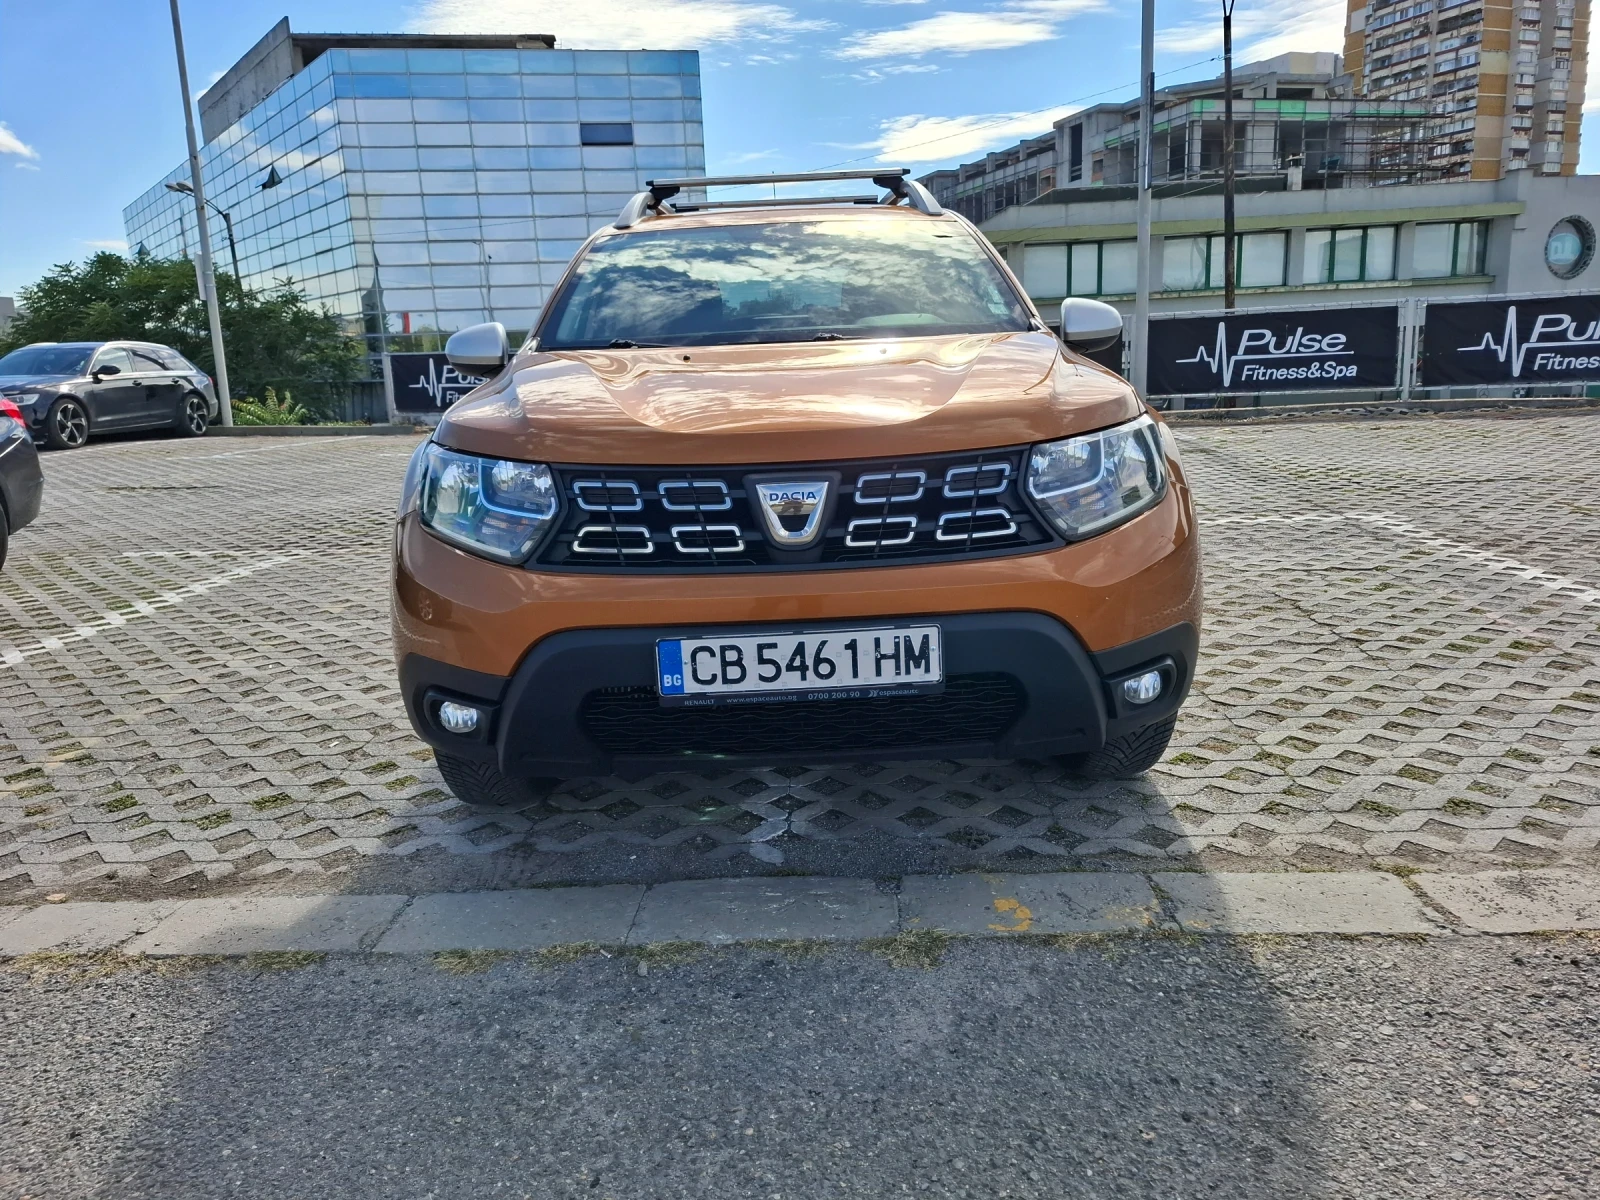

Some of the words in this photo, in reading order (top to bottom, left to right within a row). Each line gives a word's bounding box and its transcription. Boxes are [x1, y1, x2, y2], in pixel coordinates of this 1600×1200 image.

[1237, 326, 1347, 356] Pulse
[1241, 361, 1358, 381] Fitness&Spa
[1533, 353, 1600, 371] Fitnes
[769, 491, 817, 502] DACIA
[690, 644, 747, 686] CB
[756, 638, 859, 683] 5461
[873, 633, 931, 678] HM
[663, 674, 682, 687] BG
[726, 694, 798, 704] www.espaceauto.bg
[831, 691, 847, 699] 200
[849, 690, 860, 698] 90
